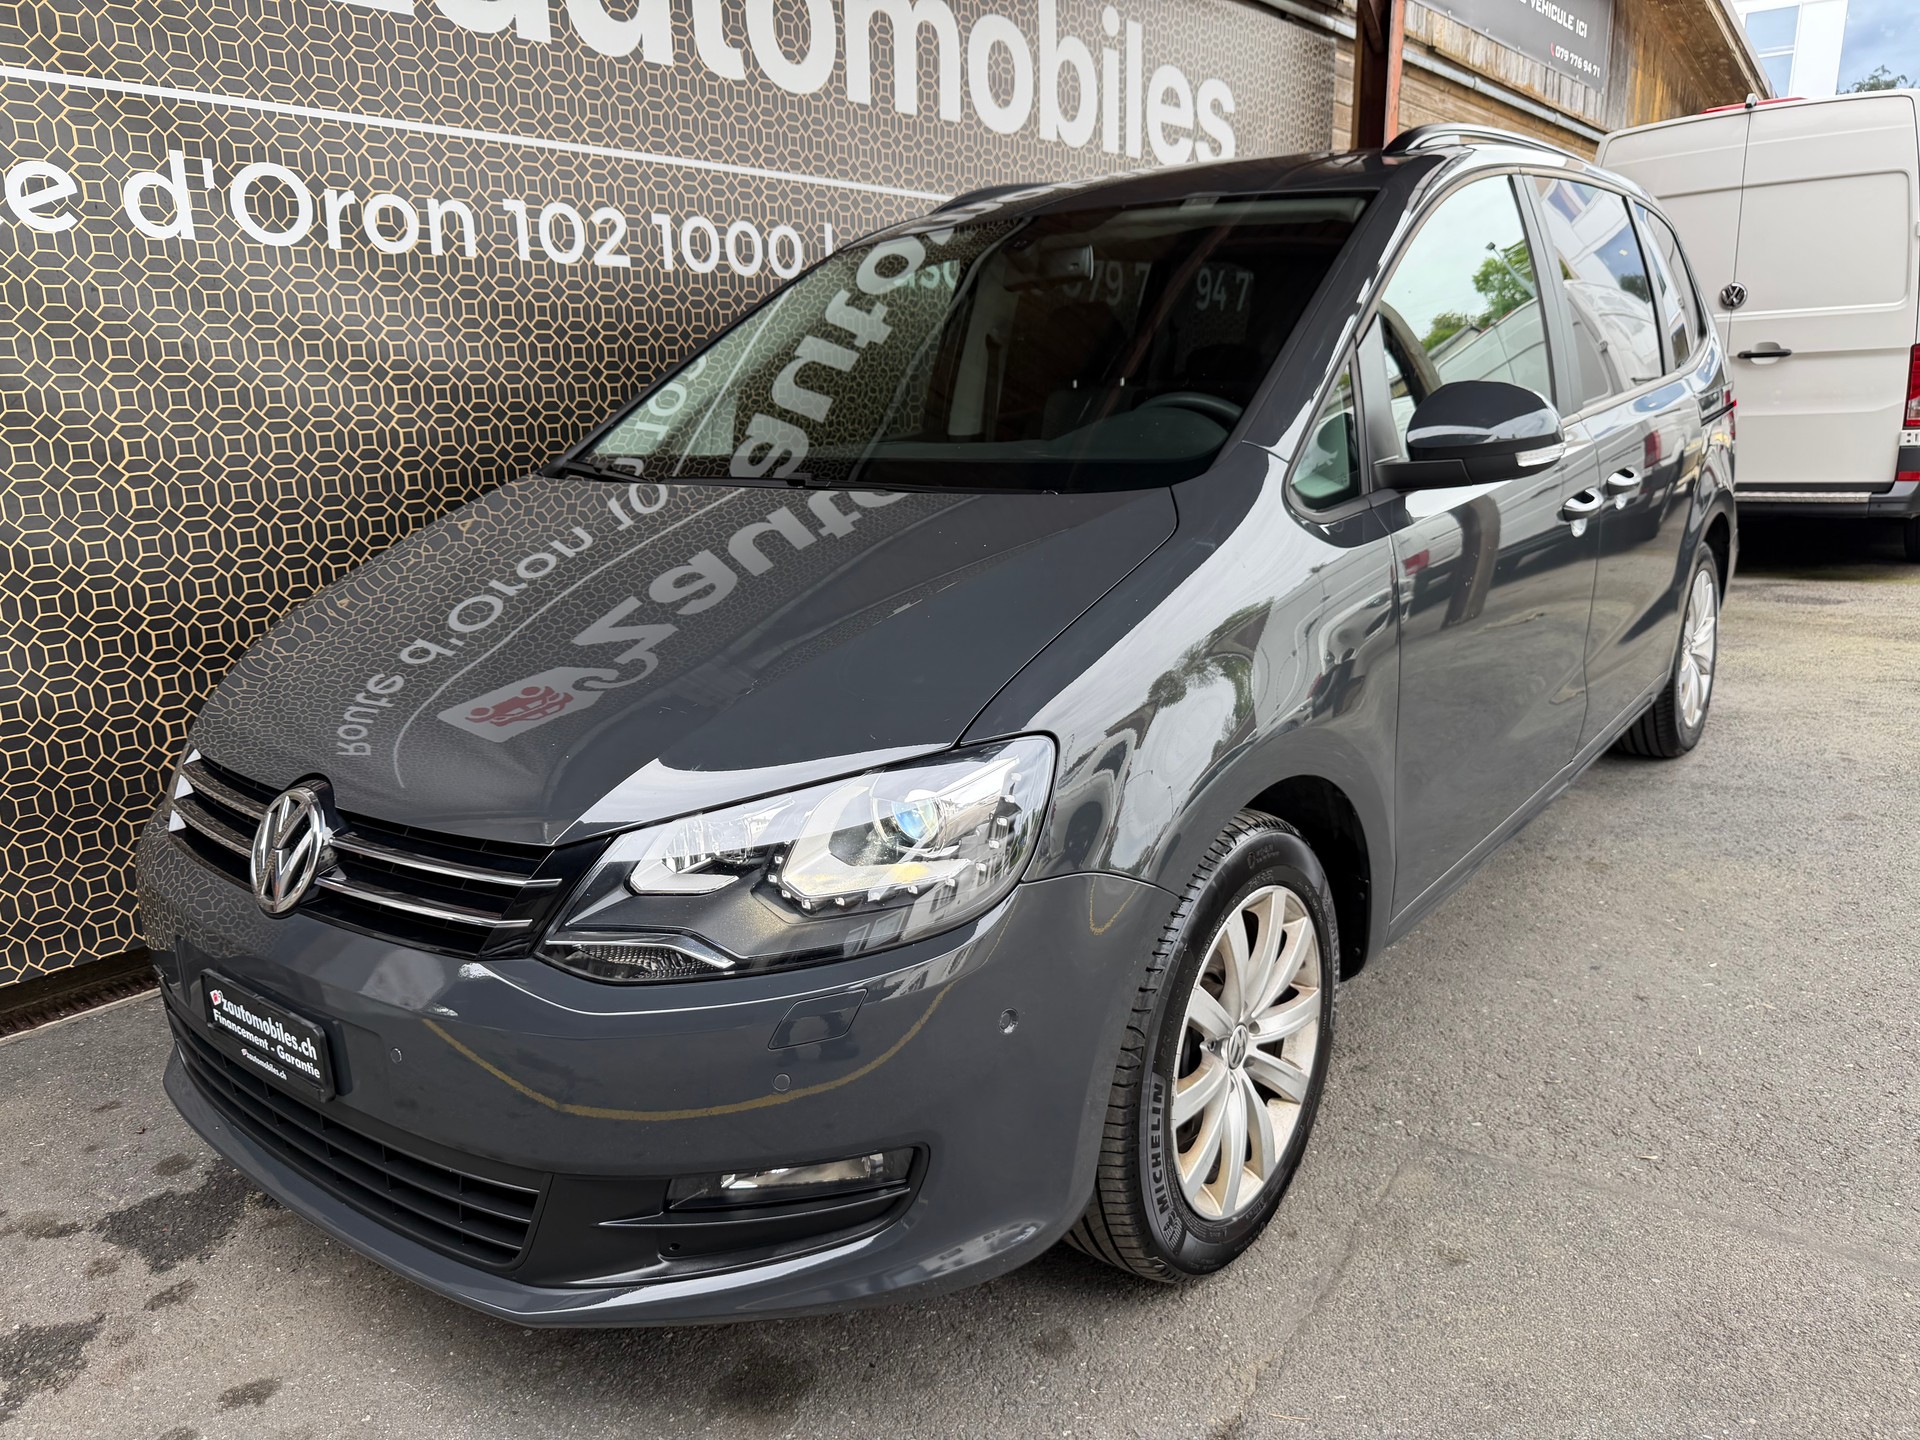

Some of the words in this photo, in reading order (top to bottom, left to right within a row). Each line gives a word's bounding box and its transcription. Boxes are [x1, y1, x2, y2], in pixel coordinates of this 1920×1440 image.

[1555, 45, 1570, 62] 079
[1569, 52, 1583, 70] 776
[1583, 59, 1593, 74] 94
[1592, 64, 1601, 79] 71
[1575, 19, 1588, 39] ICI
[123, 149, 477, 258] d'Oron
[502, 198, 632, 269] 102
[651, 212, 804, 280] 1000
[213, 1008, 270, 1051] Financement
[276, 1044, 321, 1079] Garantie
[222, 997, 318, 1061] zautomobiles.ch
[1151, 1082, 1169, 1216] MICHELIN
